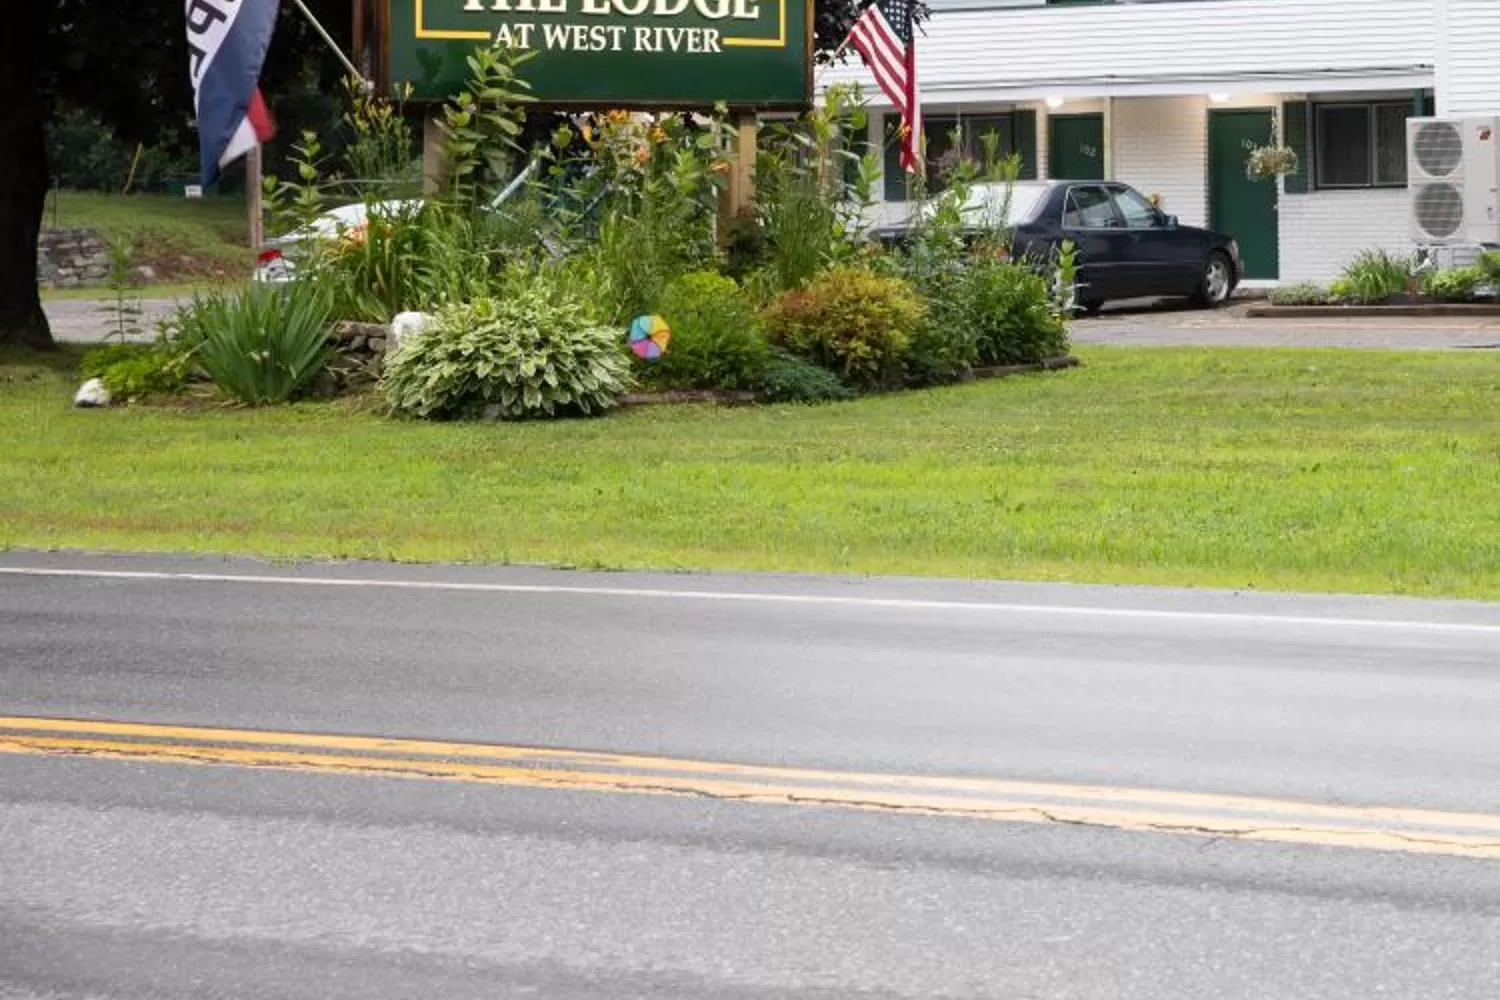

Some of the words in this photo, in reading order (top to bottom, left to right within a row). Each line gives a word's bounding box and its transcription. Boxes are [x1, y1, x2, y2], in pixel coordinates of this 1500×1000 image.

[493, 22, 535, 50] AT
[542, 22, 627, 51] WEST
[633, 25, 722, 53] RIVER
